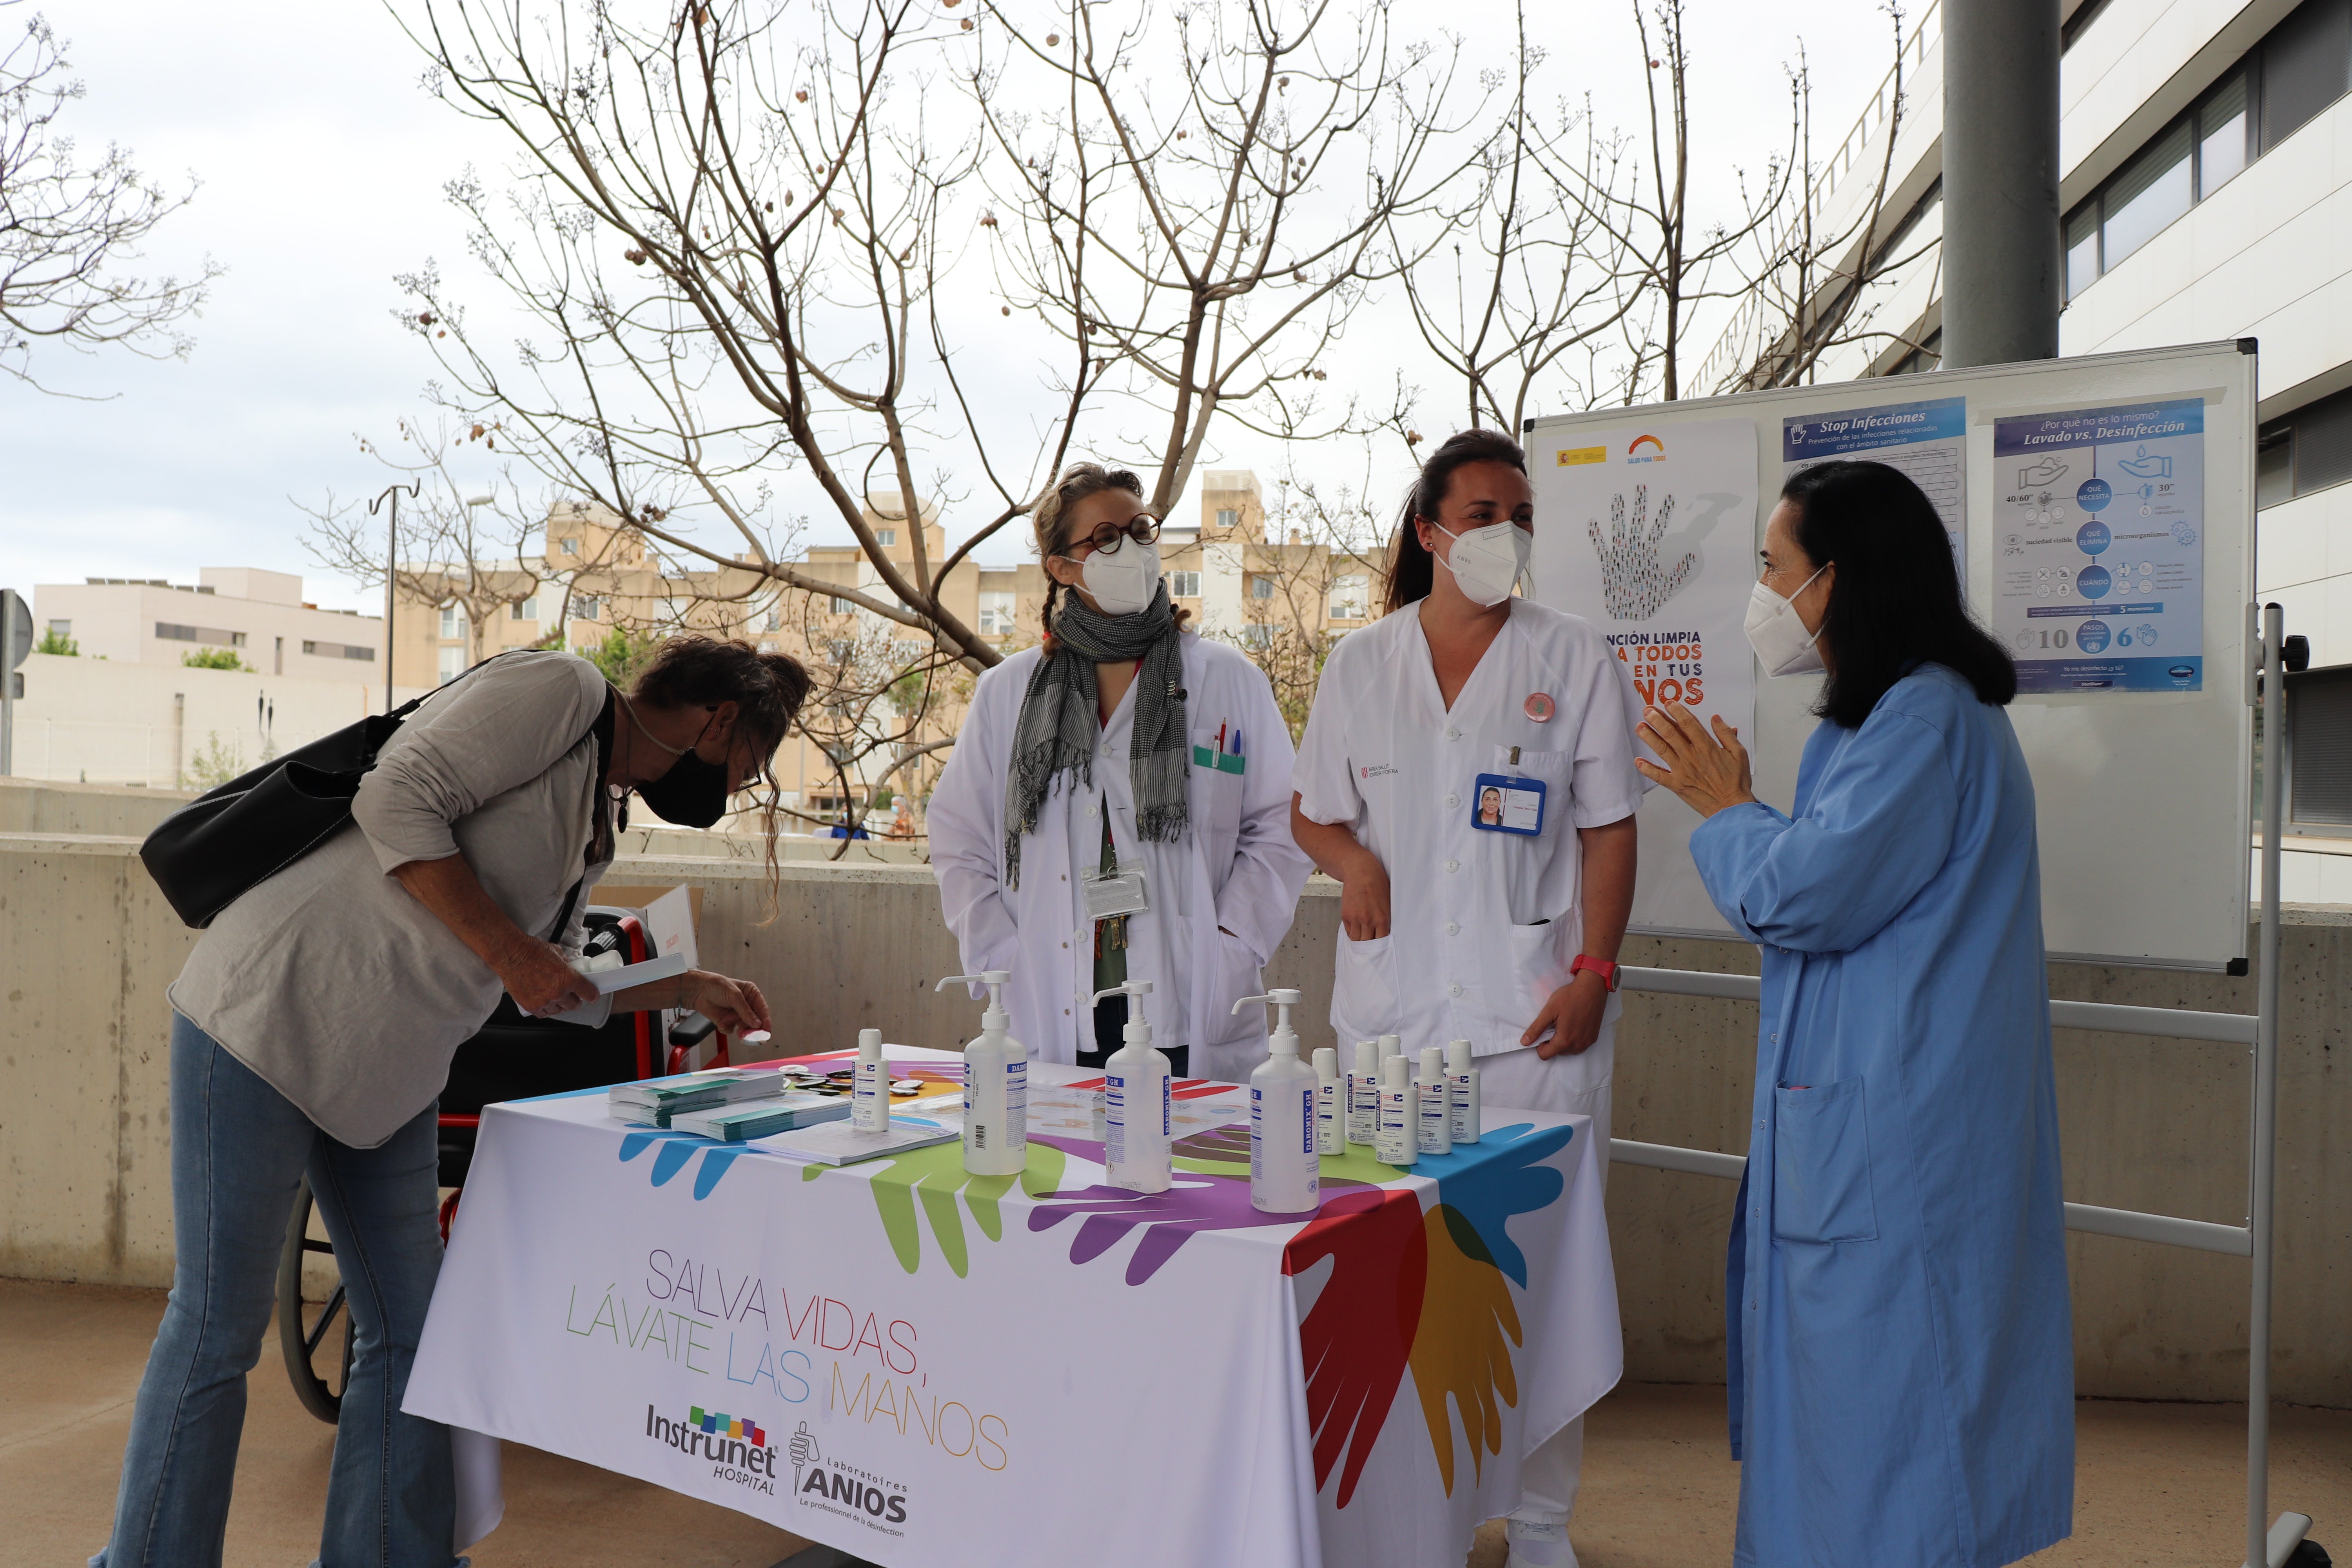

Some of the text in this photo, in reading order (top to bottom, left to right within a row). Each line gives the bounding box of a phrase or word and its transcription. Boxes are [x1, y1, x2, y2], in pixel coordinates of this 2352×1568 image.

[1820, 412, 1926, 434] Stop Infecciones
[2041, 421, 2060, 431] ¿Por
[2063, 419, 2080, 429] qué
[2111, 414, 2120, 423] lo
[2123, 410, 2159, 421] mismo?
[1808, 434, 1840, 444] Prevención
[1862, 430, 1896, 438] infecciones
[1898, 425, 1938, 434] relacionadas
[1880, 437, 1907, 445] sanitario
[2024, 420, 2185, 445] Lavado vs. Desinfección
[2114, 532, 2169, 540] microorganismos
[2079, 577, 2109, 586] CUÁNDO
[1606, 630, 1701, 645] NCIÓN LIMPIA
[2039, 629, 2069, 649] 10
[2117, 627, 2132, 647] 6
[1634, 644, 1702, 662] TODOS
[1634, 663, 1702, 677] EN TUS
[1633, 678, 1704, 706] NOS
[1110, 1078, 1118, 1086] GH
[1165, 1079, 1169, 1091] GH
[1306, 1094, 1311, 1107] GH
[646, 1249, 927, 1388] SALVA VIDAS,
[567, 1283, 1009, 1472] LÁVATE LAS MANOS
[713, 1466, 774, 1496] HOSPITAL
[802, 1468, 906, 1523] ANIOS
[800, 1497, 904, 1537] Le professionnel de la désinfection
